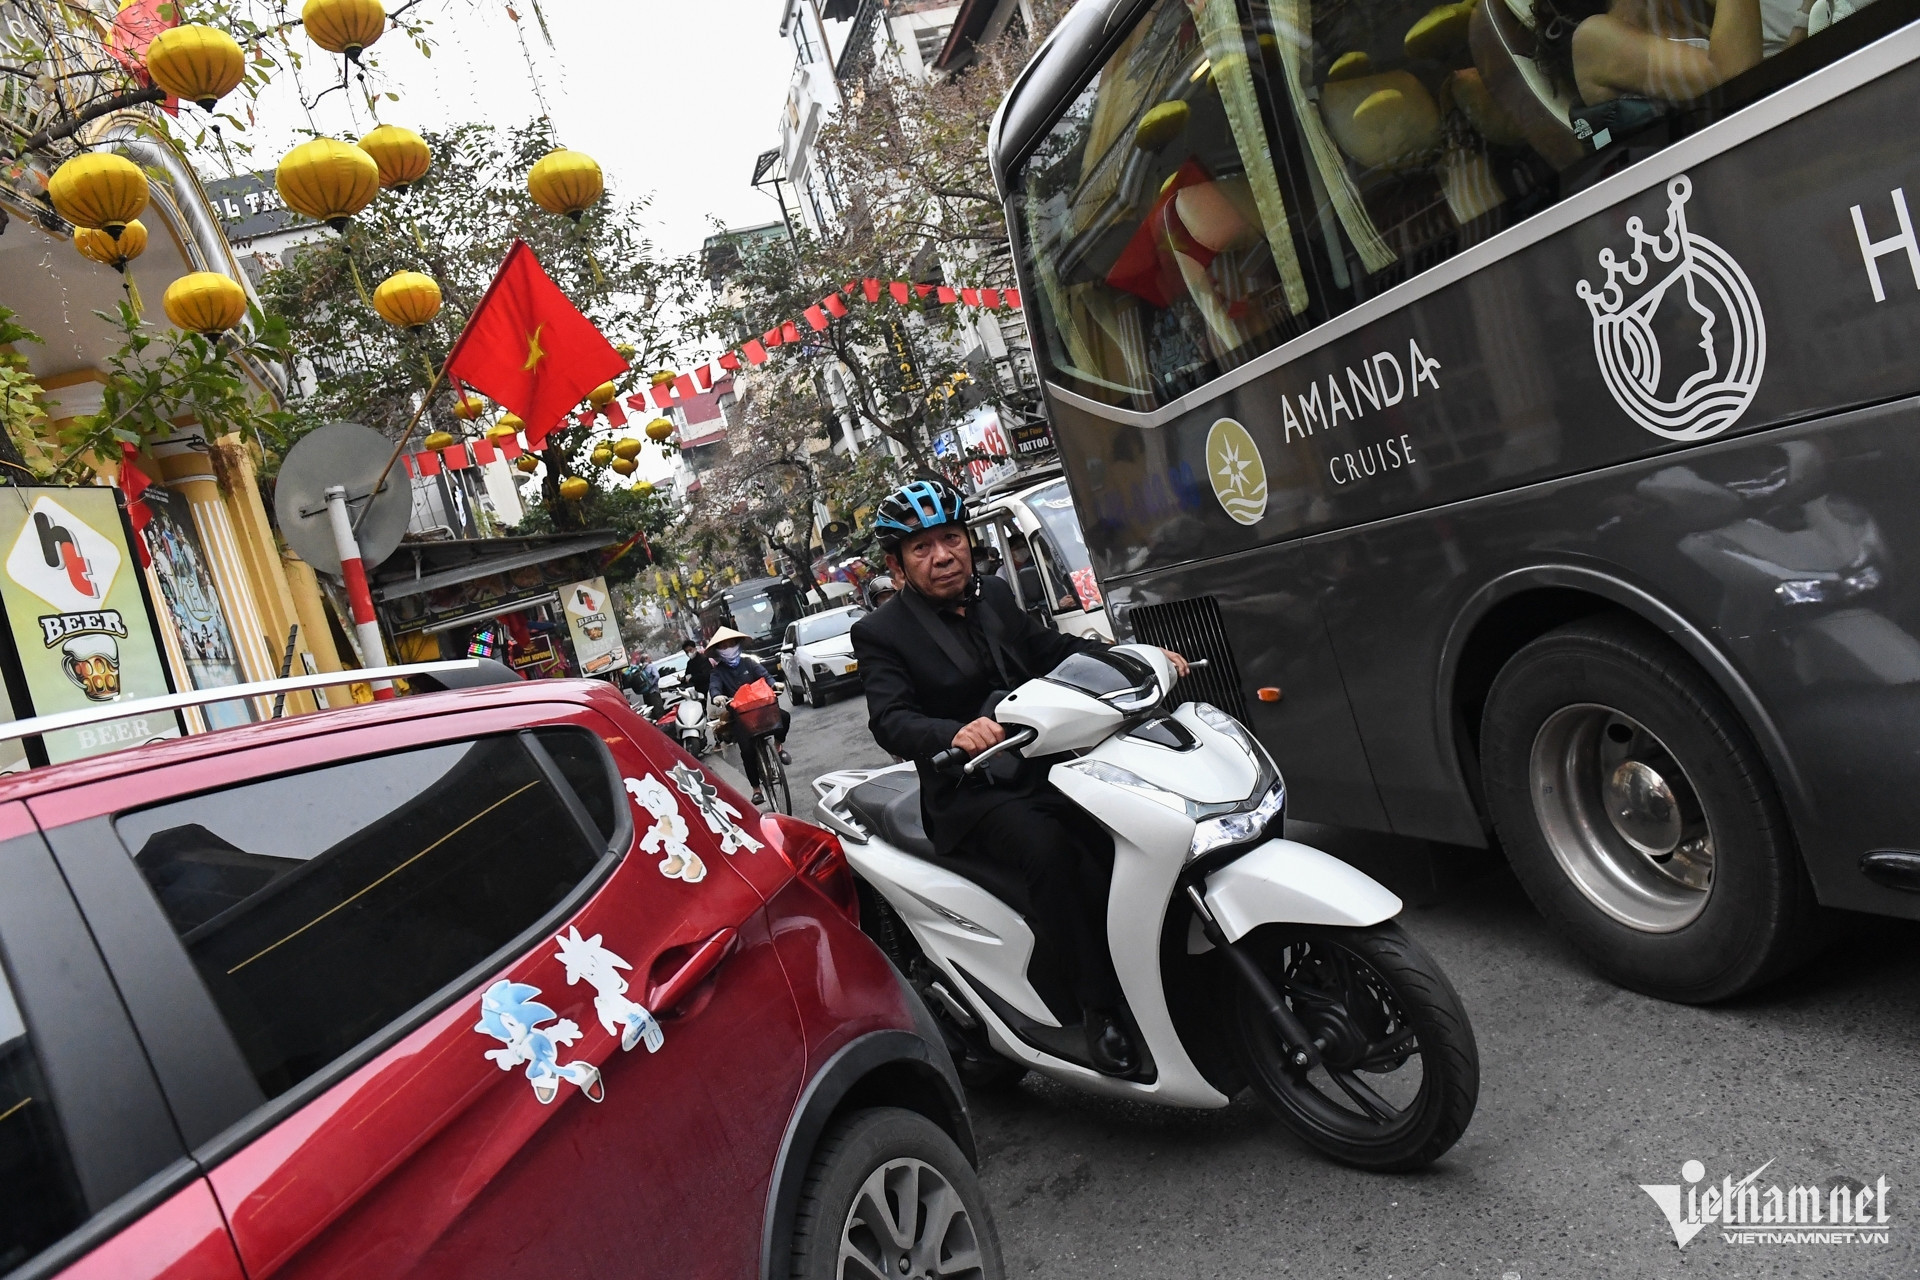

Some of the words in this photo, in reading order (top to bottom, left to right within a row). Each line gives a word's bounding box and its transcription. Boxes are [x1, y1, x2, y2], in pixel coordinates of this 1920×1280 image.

[1281, 338, 1441, 444] AMANDA
[1018, 436, 1049, 453] TATTOO
[1329, 434, 1416, 485] CRUISE
[40, 610, 128, 646] BEER
[577, 613, 606, 628] BEER
[77, 718, 152, 749] BEER
